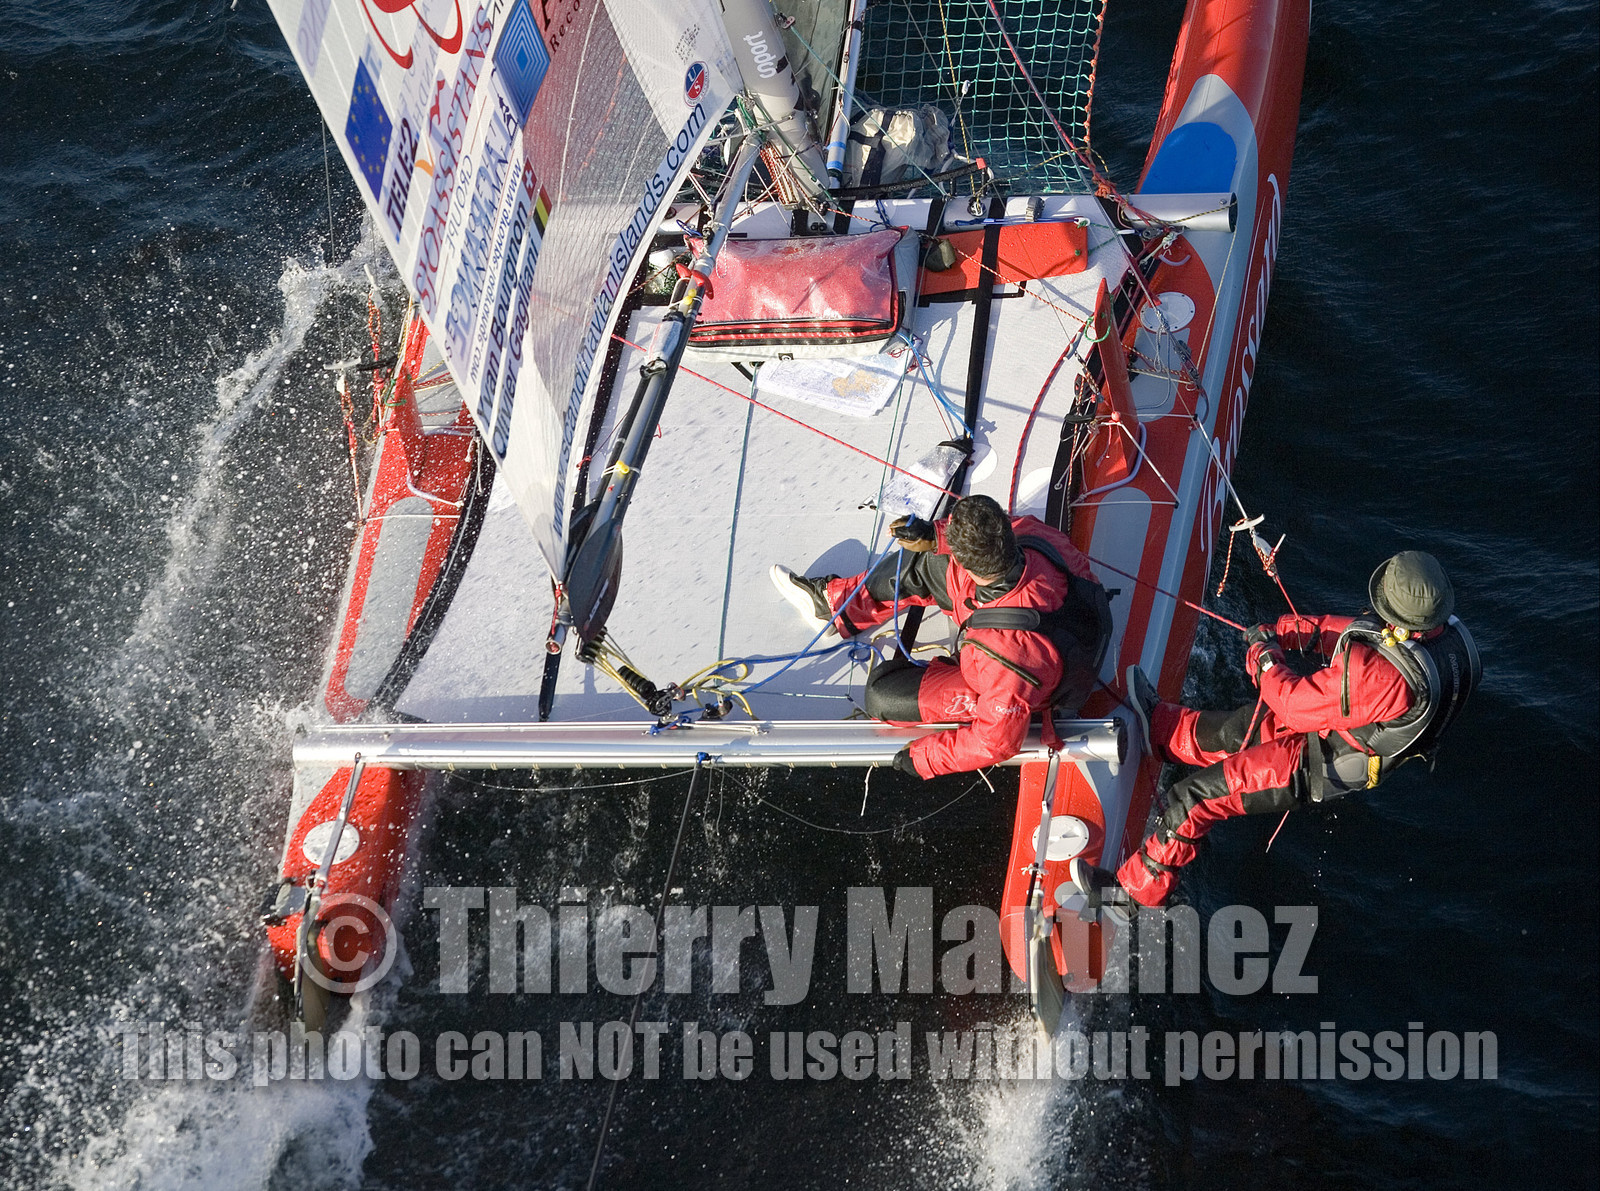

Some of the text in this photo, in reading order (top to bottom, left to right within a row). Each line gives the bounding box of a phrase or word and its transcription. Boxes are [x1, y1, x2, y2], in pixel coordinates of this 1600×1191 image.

[386, 117, 418, 233] TELE2
[476, 200, 528, 428] Yvan Bourgnon
[492, 362, 517, 459] Olivier
